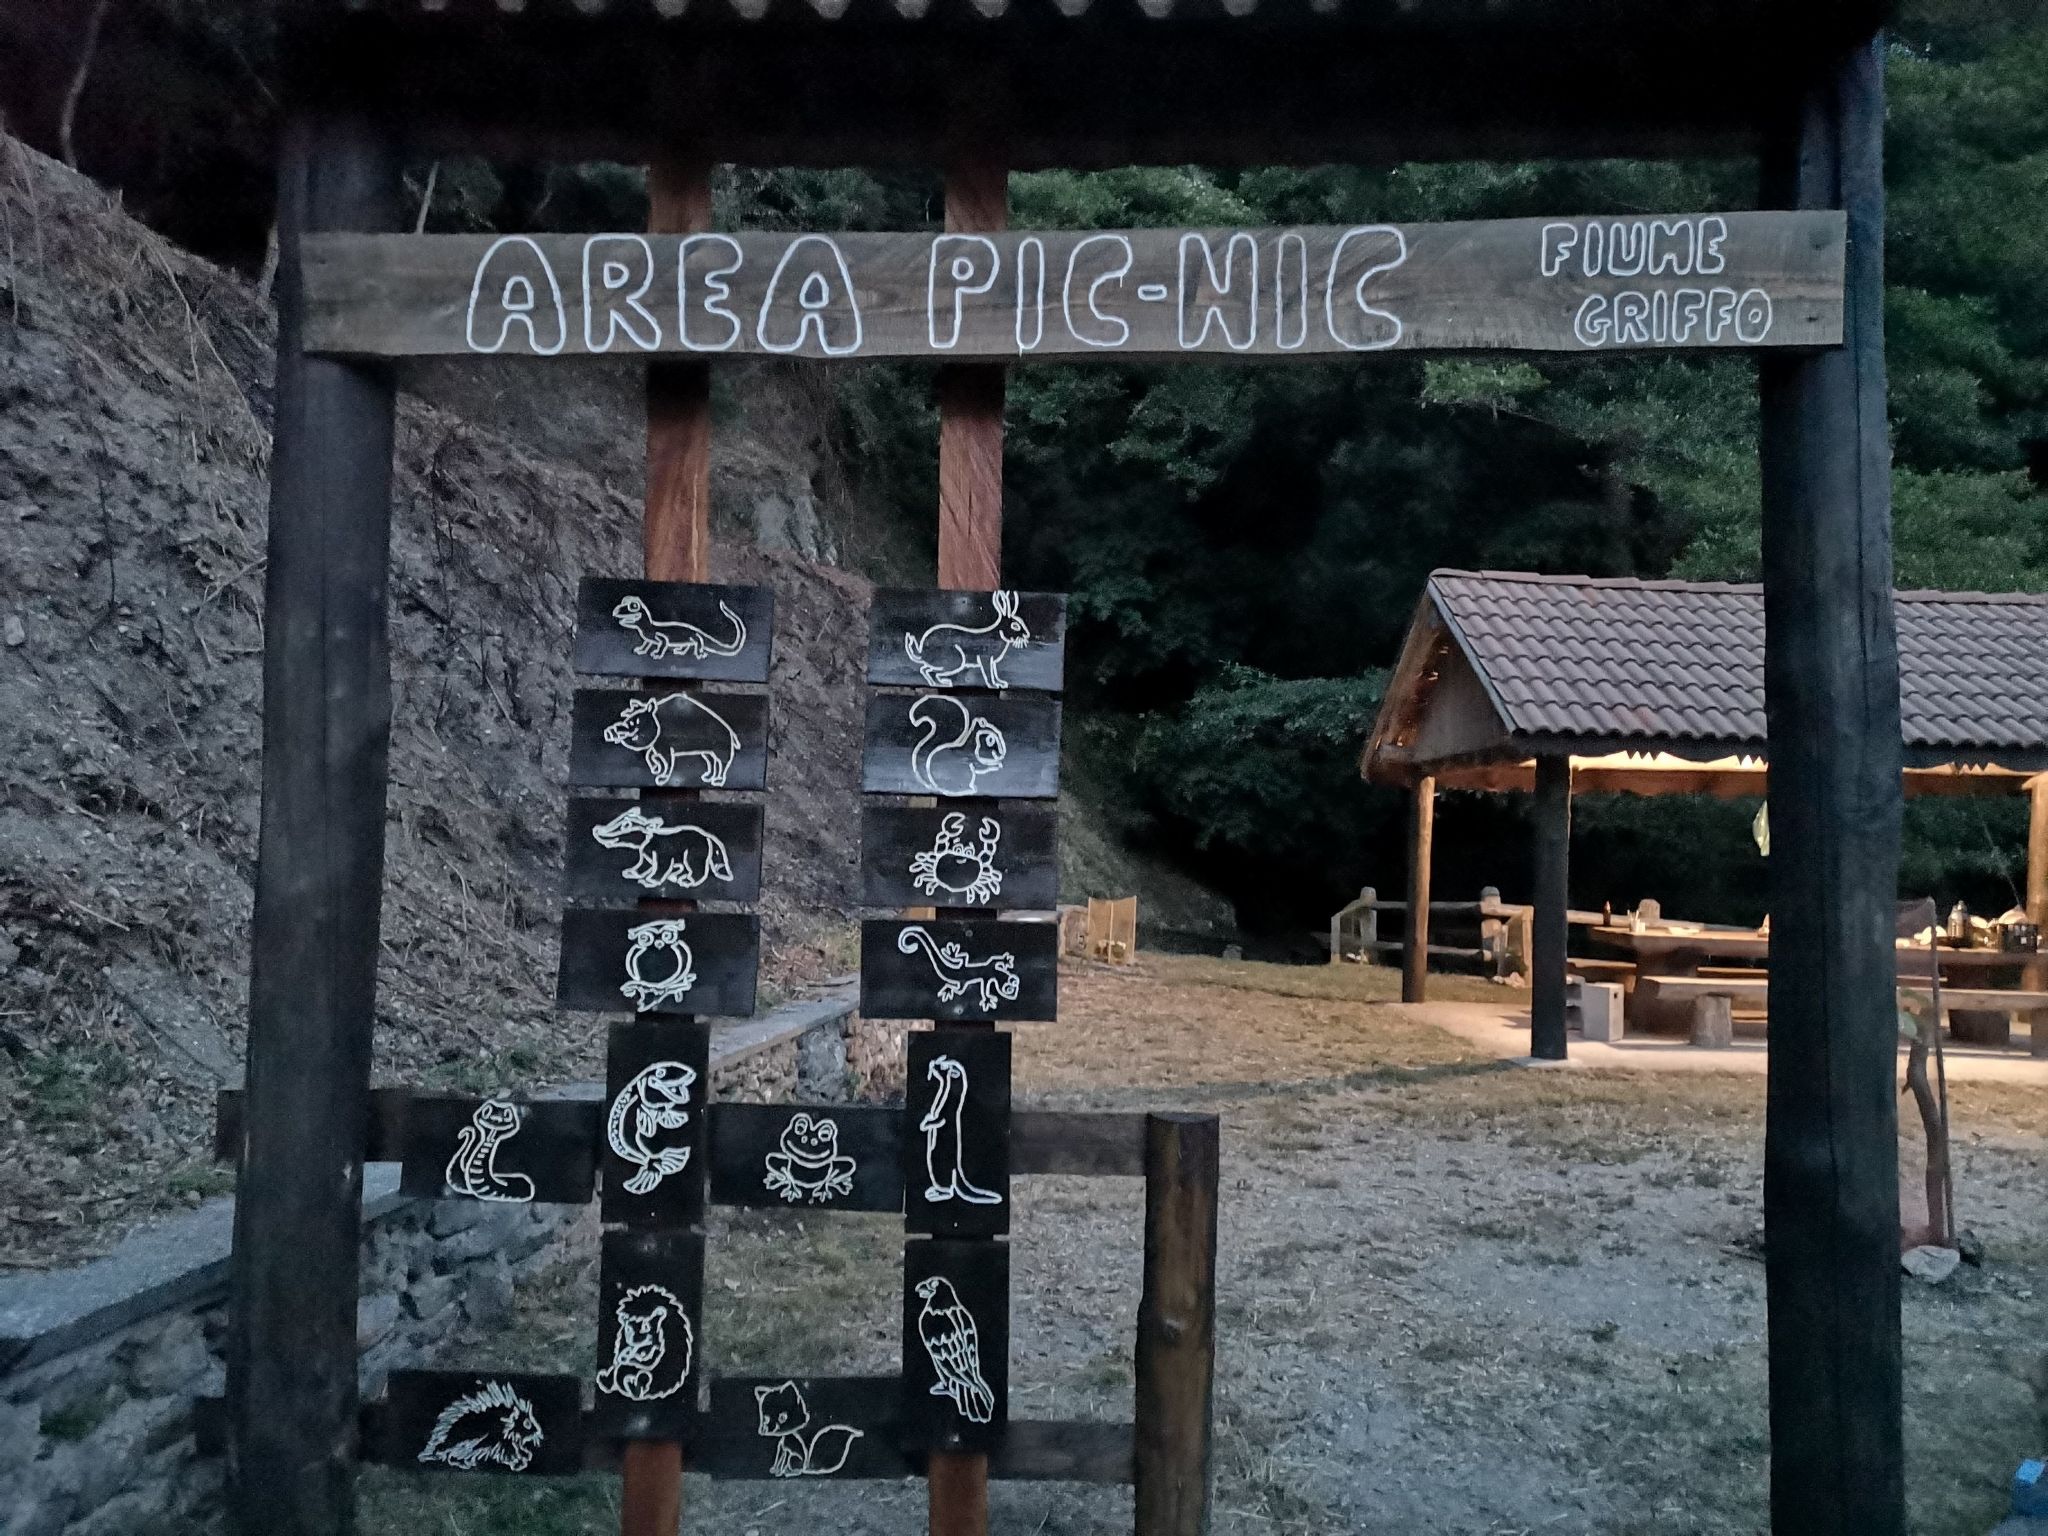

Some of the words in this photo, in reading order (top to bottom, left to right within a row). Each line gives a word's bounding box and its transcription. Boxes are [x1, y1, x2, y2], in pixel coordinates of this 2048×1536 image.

[1541, 217, 1728, 277] FIUME
[466, 234, 864, 356] AREA
[927, 224, 1408, 351] PIC-NIC
[1573, 288, 1774, 347] GRIFFO
